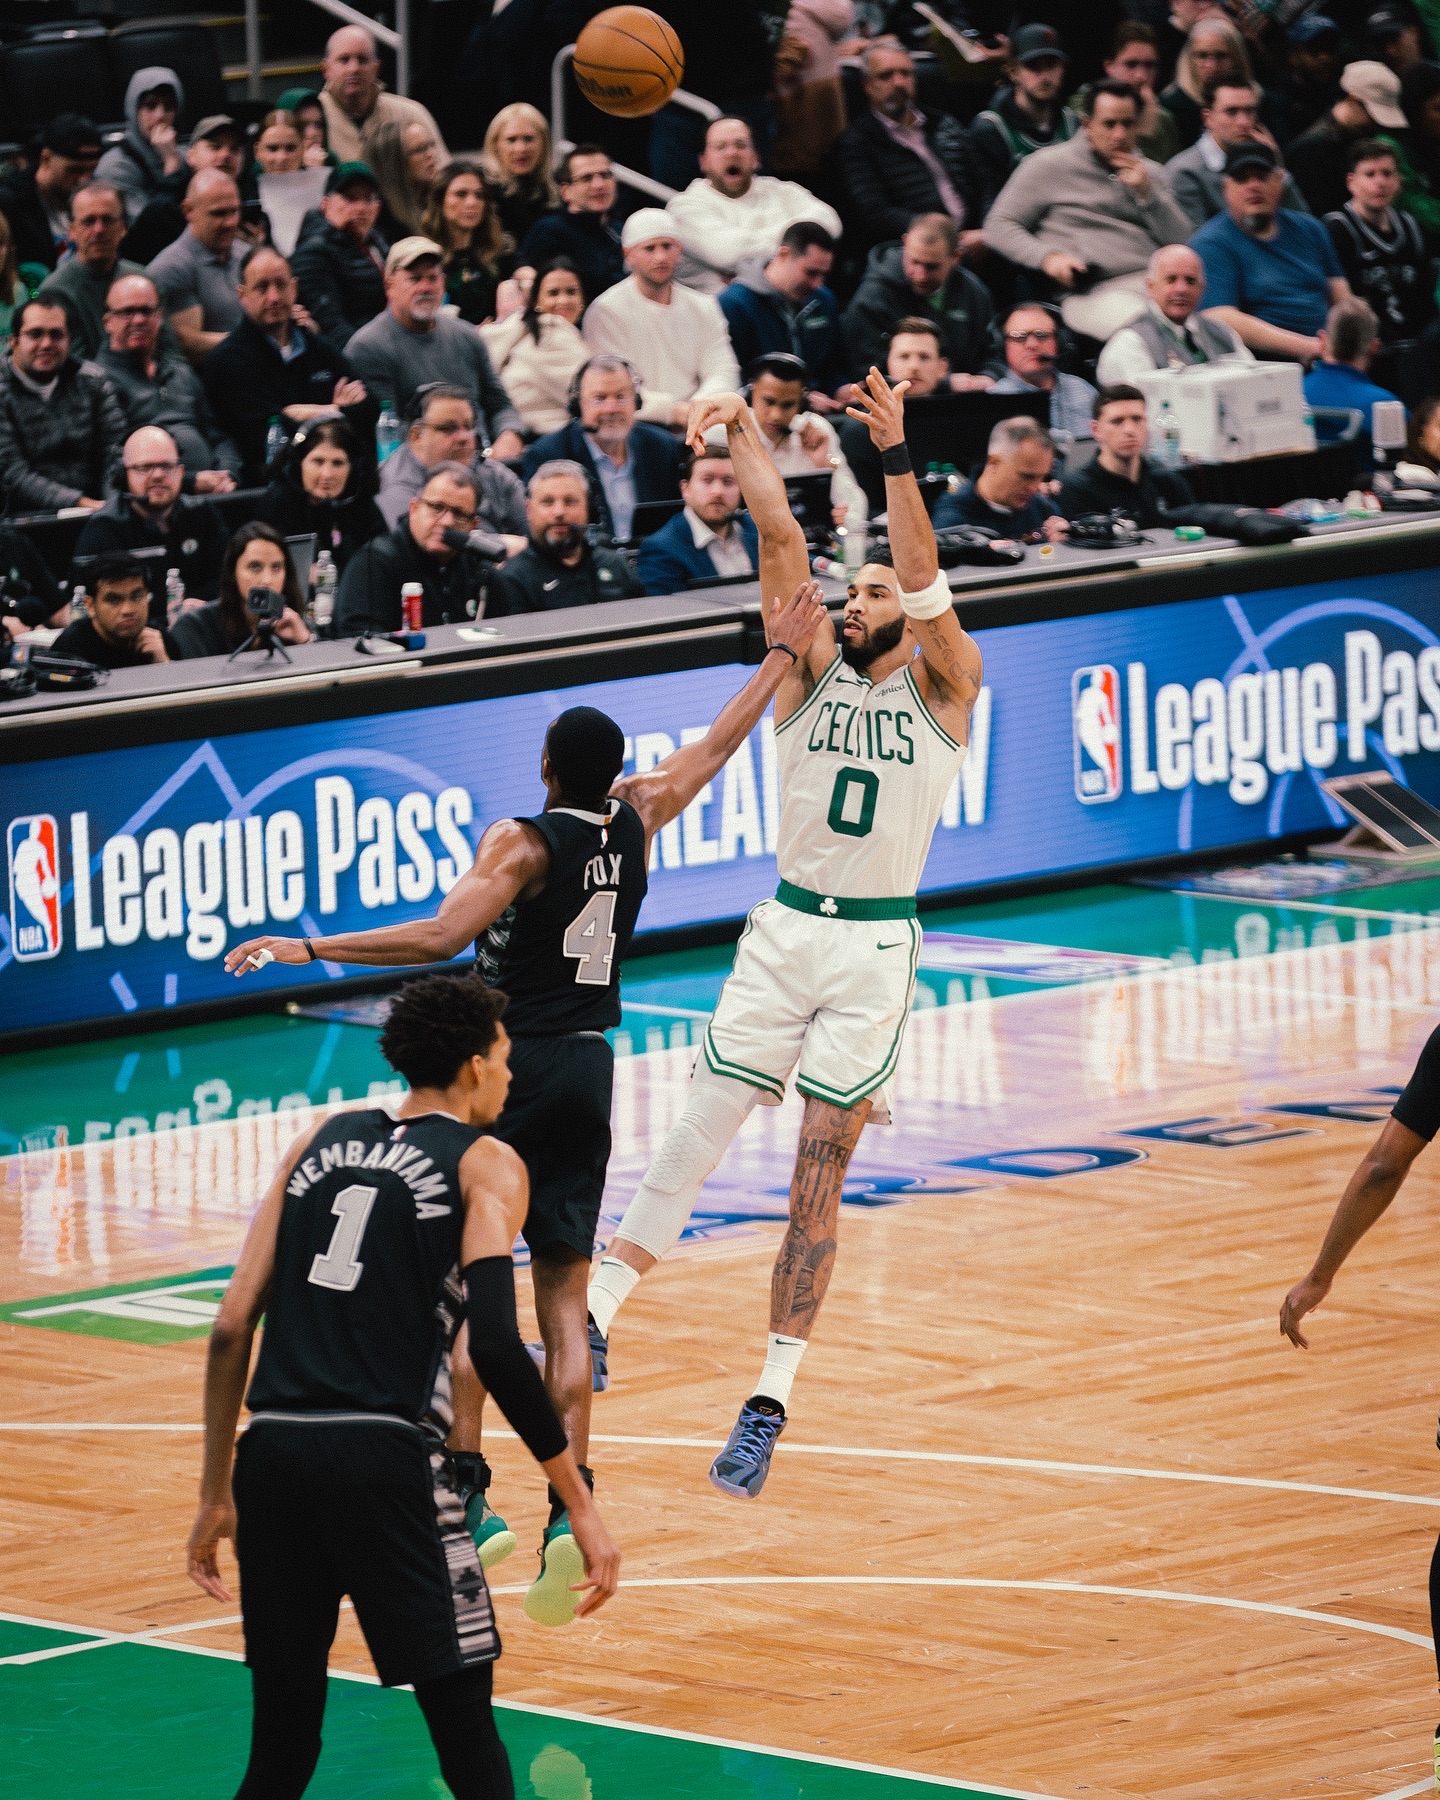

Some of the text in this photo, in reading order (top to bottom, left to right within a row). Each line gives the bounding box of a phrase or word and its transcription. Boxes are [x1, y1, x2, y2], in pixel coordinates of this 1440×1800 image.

[1126, 661, 1338, 805] League
[827, 766, 880, 838] 0
[70, 775, 475, 961] League Pass
[583, 853, 623, 890] FOX
[563, 891, 617, 986] 4
[286, 1140, 452, 1220] WEMBANYAMA
[307, 1184, 379, 1292] 1
